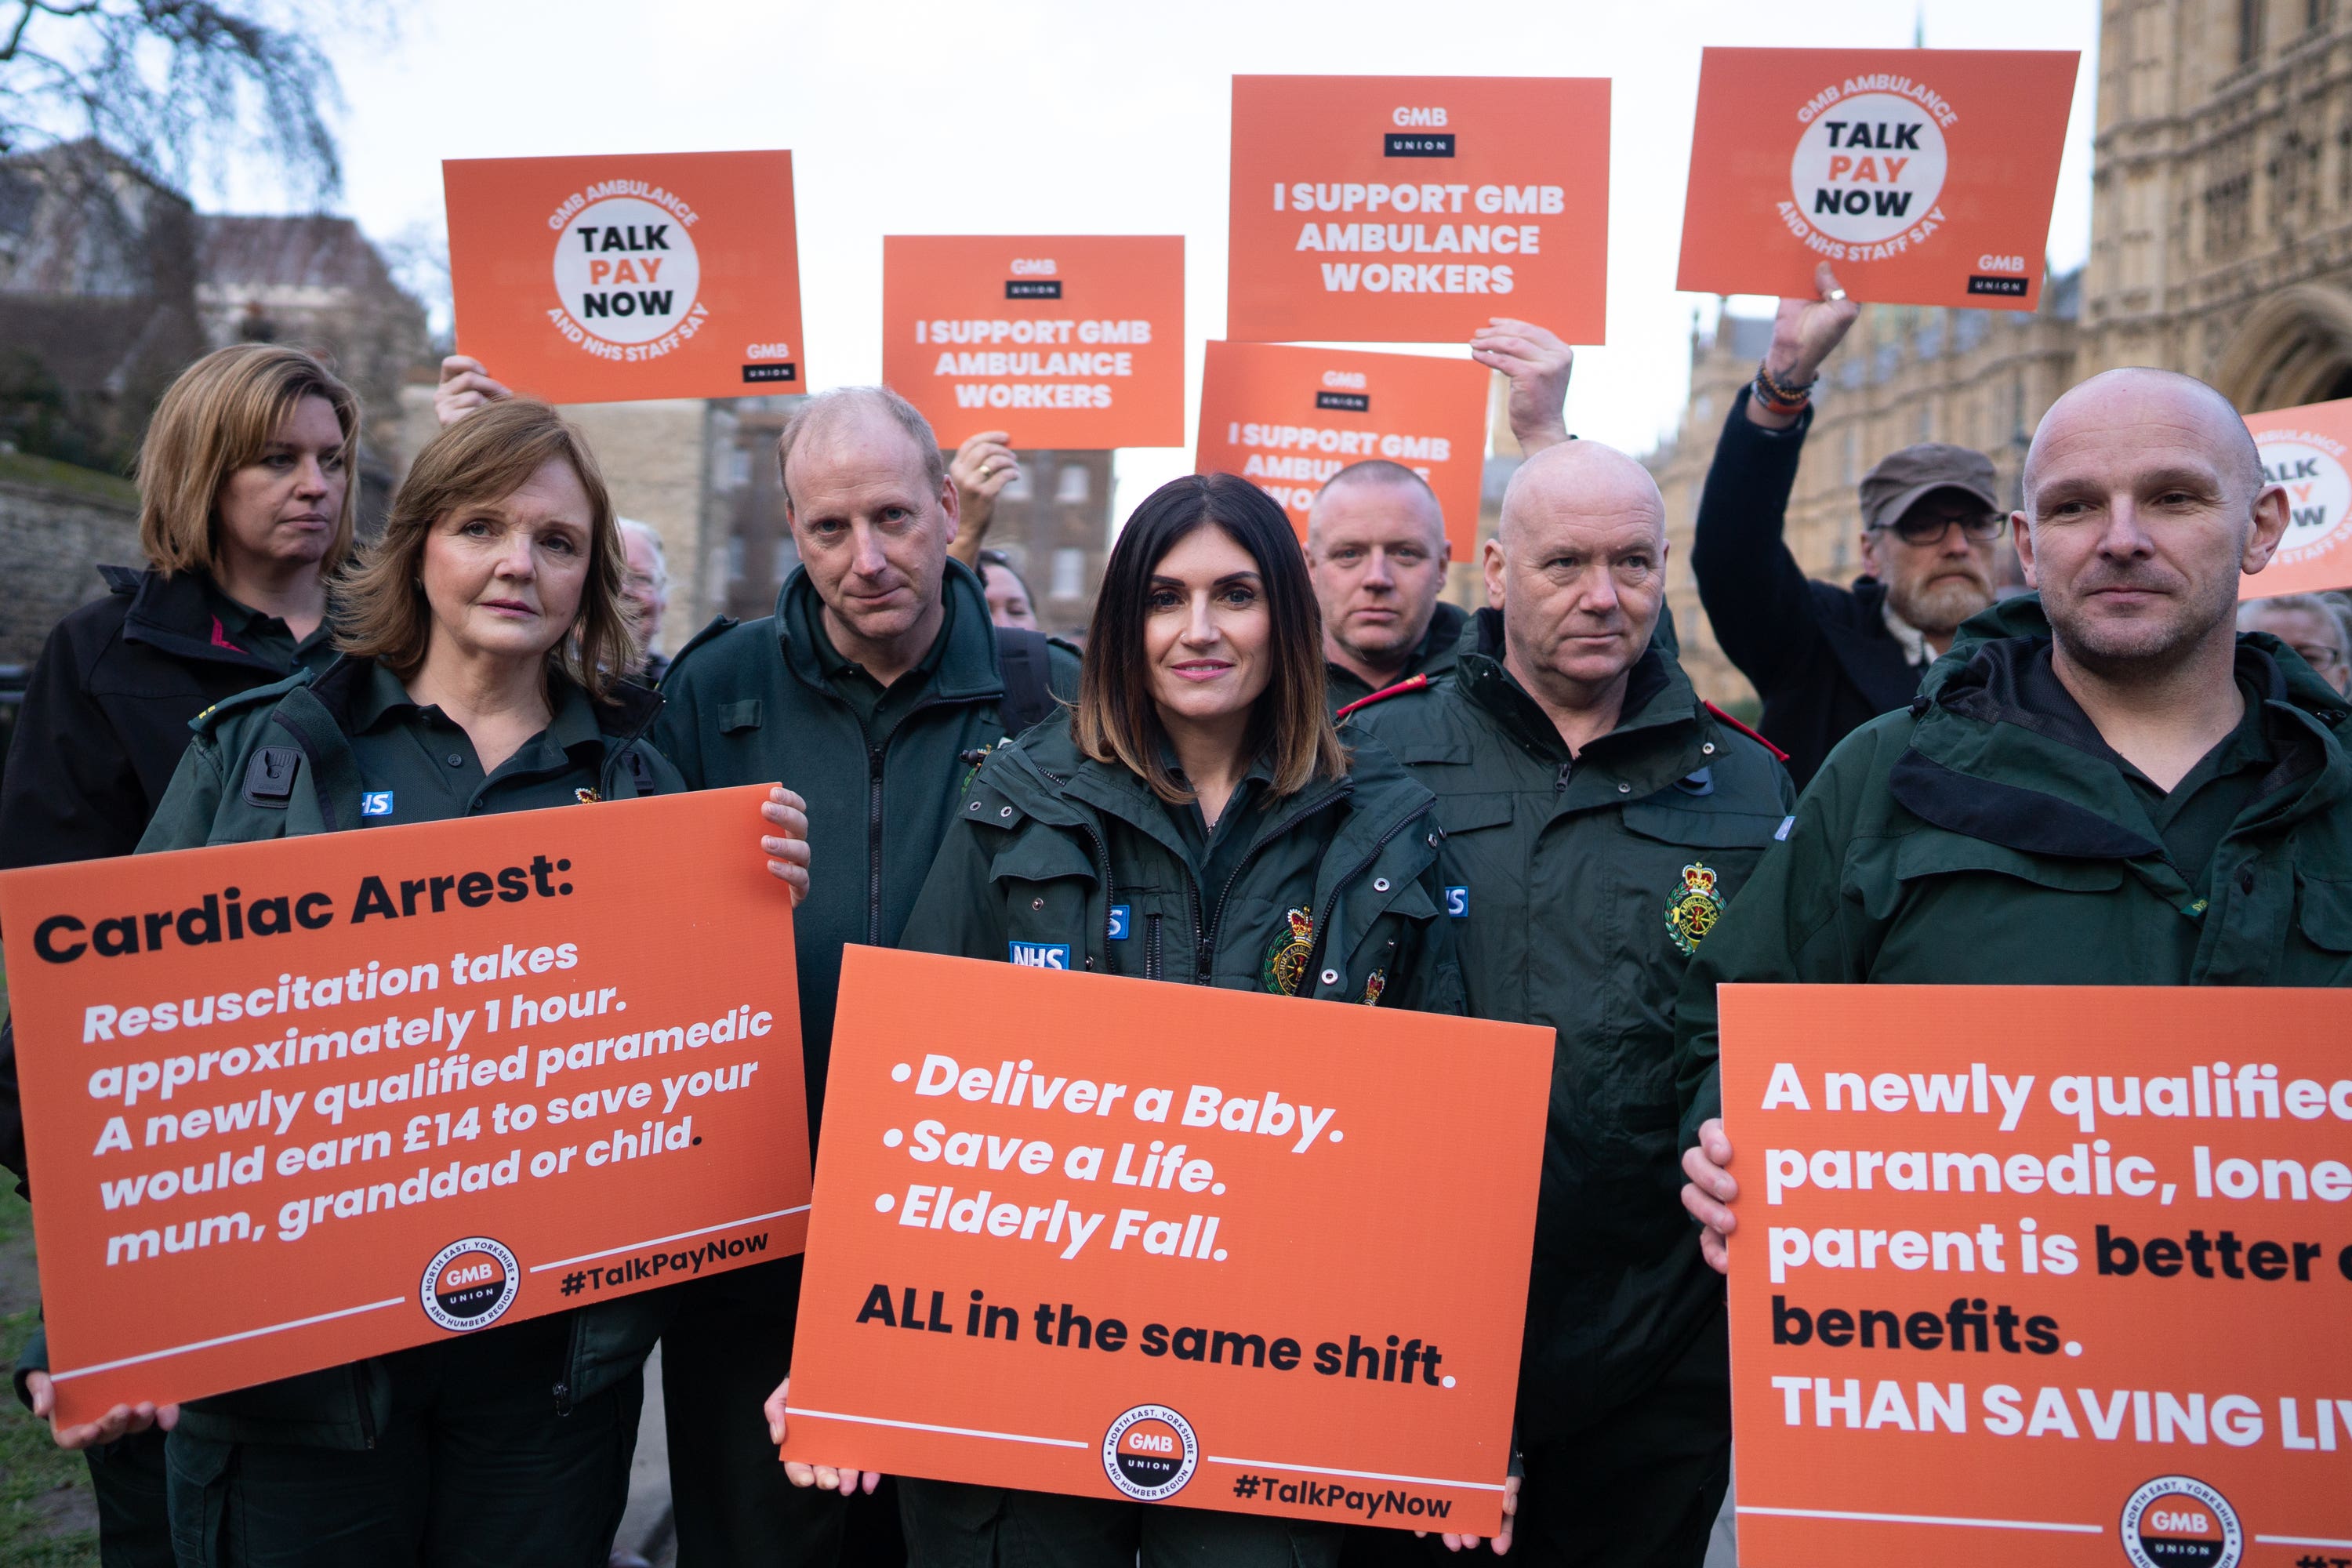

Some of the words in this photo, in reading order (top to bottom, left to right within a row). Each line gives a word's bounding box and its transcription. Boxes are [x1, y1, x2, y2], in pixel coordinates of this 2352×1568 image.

[1392, 107, 1448, 127] GMB
[1796, 86, 1840, 124] GMB
[1842, 74, 1959, 129] AMBULANCE
[1393, 140, 1446, 151] UNION
[1824, 122, 1924, 150] TALK
[1828, 156, 1909, 183] PAY
[548, 194, 586, 230] GMB
[586, 179, 699, 228] AMBULANCE
[1273, 182, 1285, 211] I
[1291, 183, 1469, 213] SUPPORT
[1474, 185, 1565, 215] GMB
[1814, 188, 1912, 217] NOW
[577, 224, 670, 252] TALK
[1295, 223, 1540, 255] AMBULANCE
[1776, 200, 1806, 238] AND
[1804, 231, 1845, 262] NHS
[1847, 237, 1909, 263] STAFF
[1907, 206, 1948, 246] SAY
[590, 258, 662, 285] PAY
[1010, 258, 1057, 275] GMB
[1320, 263, 1514, 295] WORKERS
[1978, 254, 2025, 272] GMB
[1975, 281, 2020, 292] UNION
[583, 290, 673, 318] NOW
[546, 307, 583, 343] AND
[582, 336, 623, 362] NHS
[625, 335, 681, 363] STAFF
[679, 302, 710, 339] SAY
[916, 320, 927, 344] I
[931, 320, 1075, 344] SUPPORT
[1078, 320, 1152, 344] GMB
[746, 343, 789, 361] GMB
[934, 352, 1133, 376] AMBULANCE
[748, 368, 789, 379] UNION
[1322, 370, 1367, 390] GMB
[954, 384, 1112, 408] WORKERS
[1227, 422, 1240, 445] I
[1242, 423, 1377, 456] SUPPORT
[1381, 434, 1451, 462] GMB
[34, 887, 333, 964] Cardiac
[351, 855, 572, 924] Arrest:
[1014, 946, 1064, 971] NHS
[83, 964, 439, 1044] Resuscitation
[451, 943, 578, 985] takes
[89, 1007, 476, 1106] approximately
[485, 1000, 500, 1033] 1
[510, 987, 626, 1029] hour.
[93, 1116, 132, 1156] A
[145, 1089, 306, 1146] newly
[314, 1045, 528, 1125] qualified
[535, 1004, 772, 1087] paramedic
[1761, 1062, 1811, 1111] A
[1824, 1063, 2035, 1131] newly
[915, 1054, 1127, 1116] Deliver
[1134, 1087, 1174, 1123] a
[1181, 1085, 1344, 1154] Baby.
[100, 1145, 265, 1210] would
[276, 1131, 391, 1176] earn
[403, 1106, 481, 1152] £14
[492, 1103, 537, 1134] to
[546, 1083, 652, 1123] save
[662, 1062, 758, 1114] your
[909, 1120, 1054, 1175] Save
[1063, 1145, 1105, 1181] a
[1112, 1140, 1226, 1196] Life.
[1765, 1139, 2176, 1205] paramedic,
[2194, 1146, 2352, 1201] lone
[107, 1212, 265, 1265] mum,
[278, 1149, 521, 1241] granddad
[530, 1145, 577, 1178] or
[586, 1116, 702, 1167] child.
[898, 1184, 1105, 1260] Elderly
[1110, 1208, 1228, 1261] Fall.
[425, 1259, 444, 1292] NORTH
[444, 1243, 470, 1259] EAST,
[474, 1241, 515, 1273] YORKSHIRE
[561, 1233, 768, 1296] #TalkPayNow
[1768, 1224, 2005, 1283] parent
[2019, 1217, 2078, 1275] is
[2096, 1225, 2321, 1282] better
[446, 1263, 493, 1286] GMB
[430, 1305, 446, 1321] AND
[446, 1316, 486, 1327] HUMBER
[488, 1287, 514, 1319] REGION
[449, 1288, 494, 1304] UNION
[857, 1285, 952, 1333] ALL
[967, 1290, 1018, 1340] in
[1035, 1305, 1127, 1352] the
[1141, 1324, 1301, 1370] same
[1314, 1335, 1456, 1388] shift.
[1773, 1296, 2082, 1356] benefits.
[1771, 1376, 1966, 1433] THAN
[1982, 1385, 2263, 1446] SAVING
[1109, 1417, 1131, 1446] NORTH
[1131, 1409, 1158, 1420] EAST,
[1161, 1411, 1194, 1455] YORKSHIRE
[1129, 1432, 1174, 1453] GMB
[1108, 1462, 1121, 1481] AND
[1120, 1480, 1157, 1497] HUMBER
[1160, 1469, 1189, 1495] REGION
[1127, 1460, 1170, 1471] UNION
[1234, 1475, 1451, 1519] #TalkPayNow
[2126, 1492, 2150, 1529] NORTH
[2149, 1481, 2181, 1495] EAST,
[2186, 1483, 2236, 1534] YORKSHIRE
[2151, 1510, 2209, 1534] GMB
[2154, 1544, 2210, 1555] UNION
